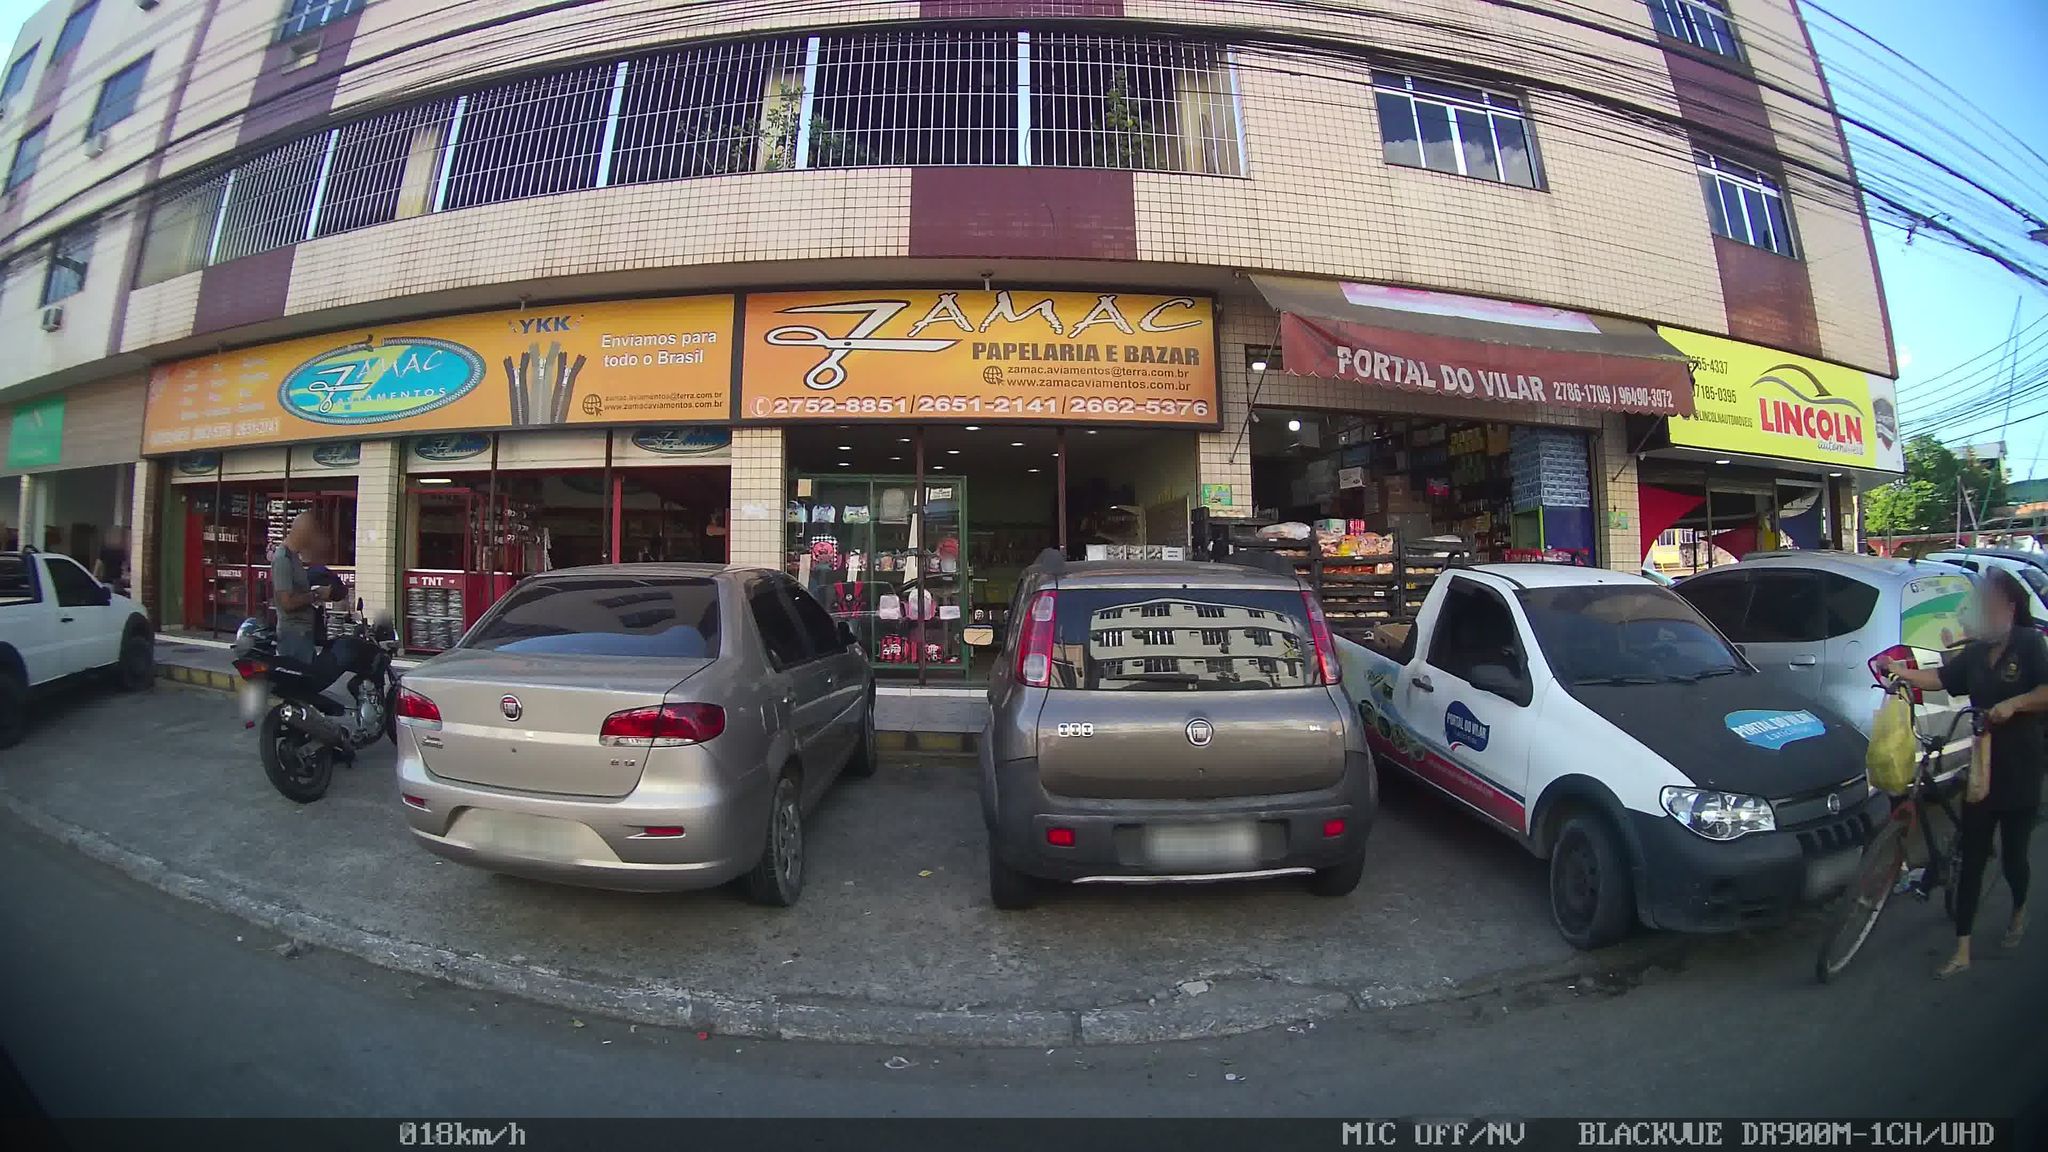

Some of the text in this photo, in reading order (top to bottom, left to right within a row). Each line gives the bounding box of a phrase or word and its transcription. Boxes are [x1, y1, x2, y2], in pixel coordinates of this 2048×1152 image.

[519, 315, 571, 334] YKK
[601, 331, 718, 349] Enviamos para
[764, 290, 1203, 390] ZAMAC
[604, 350, 704, 368] todo o Brasil
[972, 342, 1200, 365] PAPELARIA E BAZAR
[1007, 365, 1189, 378] zamac.aviamentos@terra.com.br
[1687, 355, 1728, 374] 55-4337
[1007, 377, 1191, 391] www.zamacaviamentos.com.br
[1337, 345, 1437, 388] PORTAL
[1439, 364, 1475, 394] DO
[1477, 370, 1547, 402] VILAR
[1553, 381, 1610, 404] 2786-1709
[1693, 384, 1736, 403] 7185-0395
[773, 396, 907, 414] 2752-8851
[918, 394, 1057, 414] 2651-2141
[1070, 396, 1208, 416] 2662-5376
[1759, 397, 1863, 445] LINCOLN
[421, 576, 444, 586] TNT
